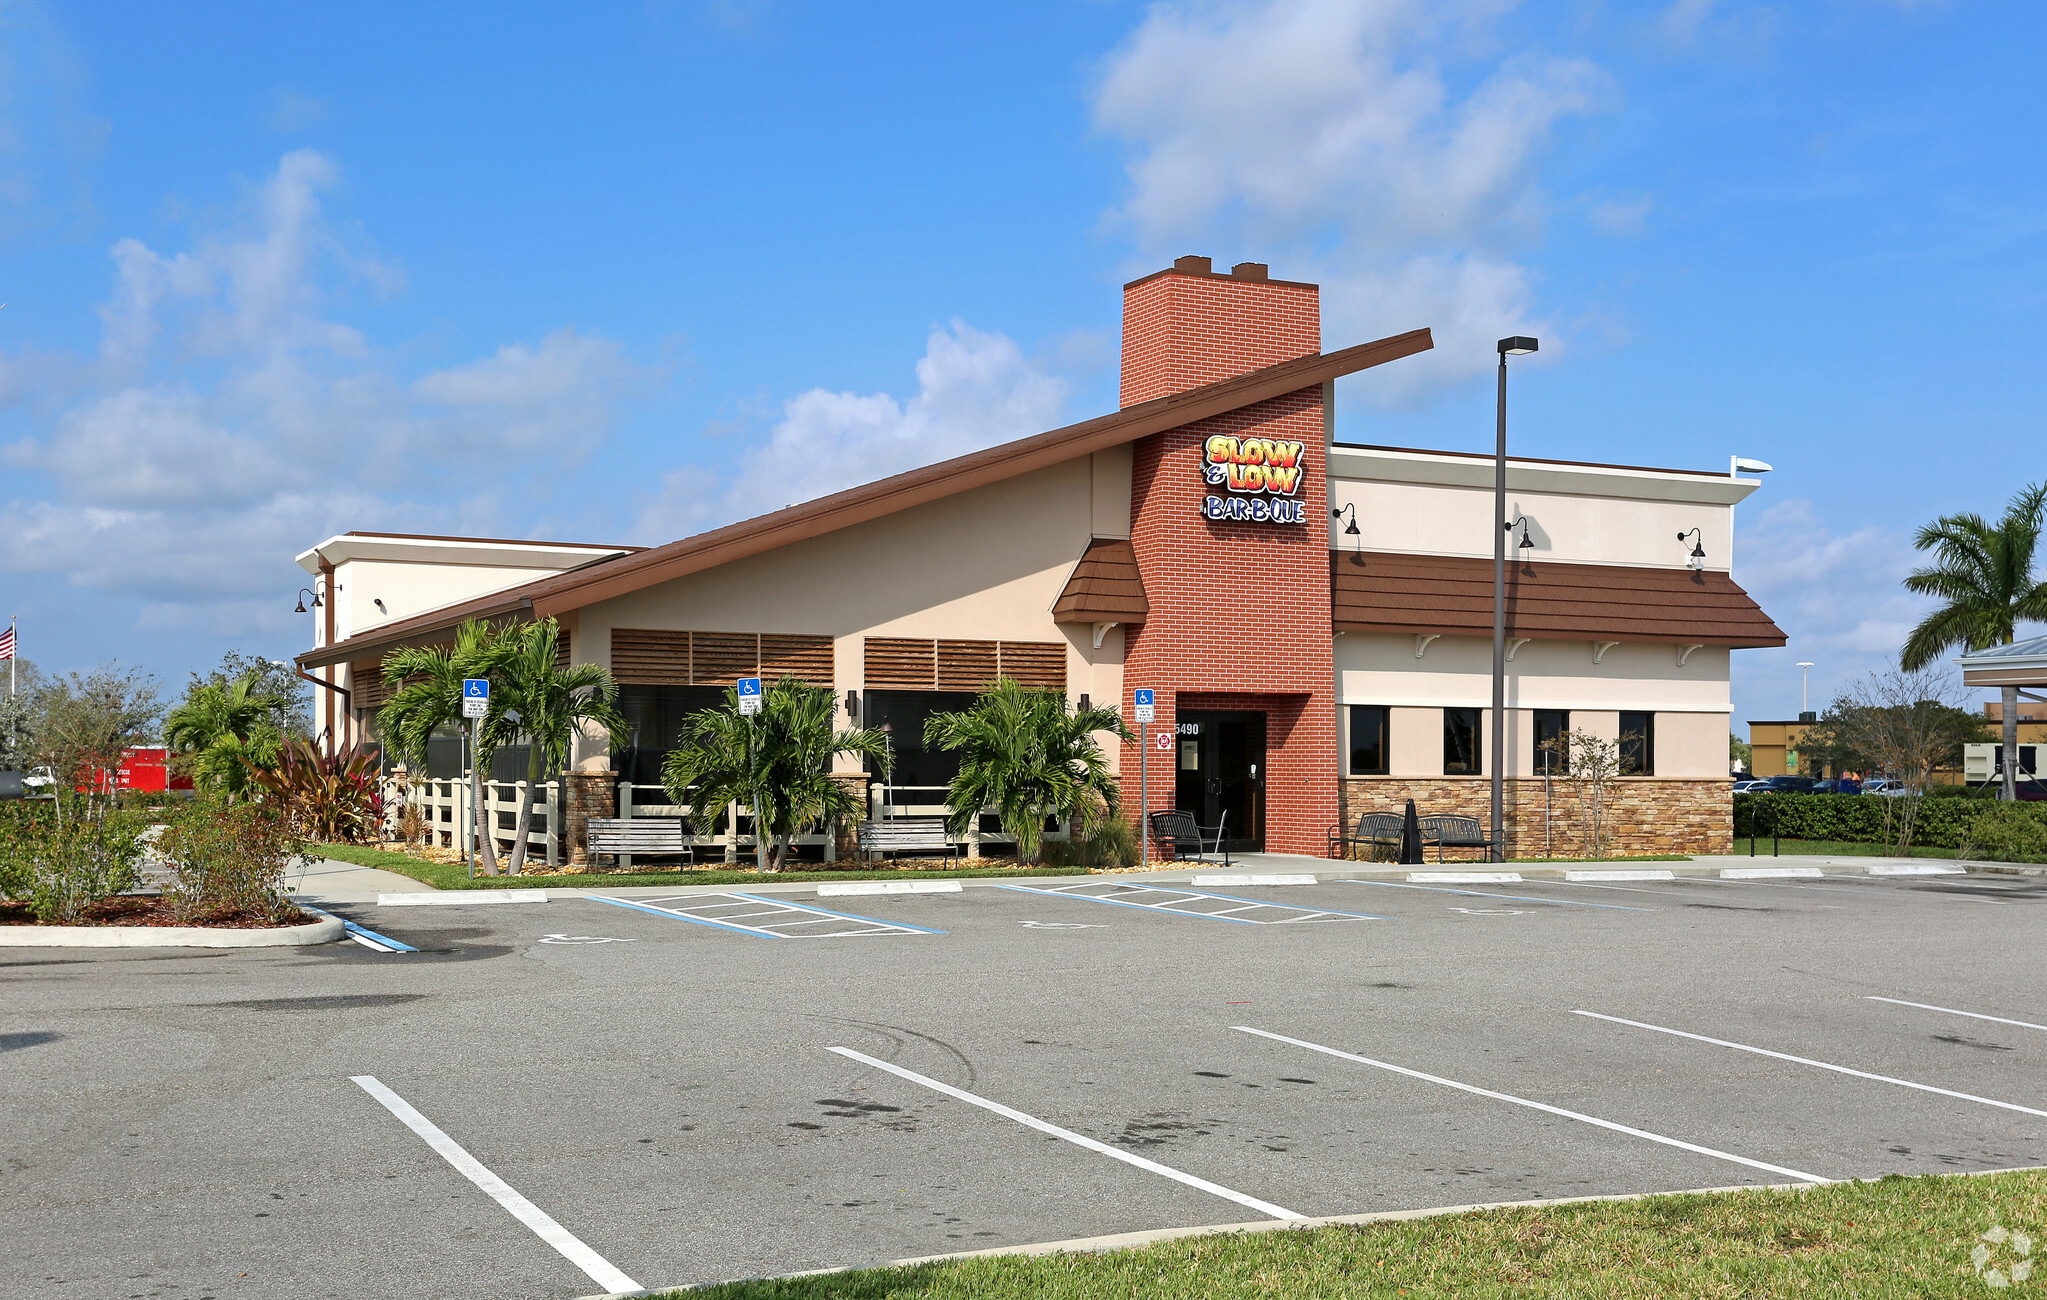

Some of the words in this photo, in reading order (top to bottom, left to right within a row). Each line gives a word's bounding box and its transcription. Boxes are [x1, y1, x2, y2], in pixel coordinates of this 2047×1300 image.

[1207, 436, 1302, 468] SLOW
[1207, 465, 1226, 482] &
[1228, 463, 1299, 493] LOW
[1207, 497, 1305, 522] BAR-B-QUE
